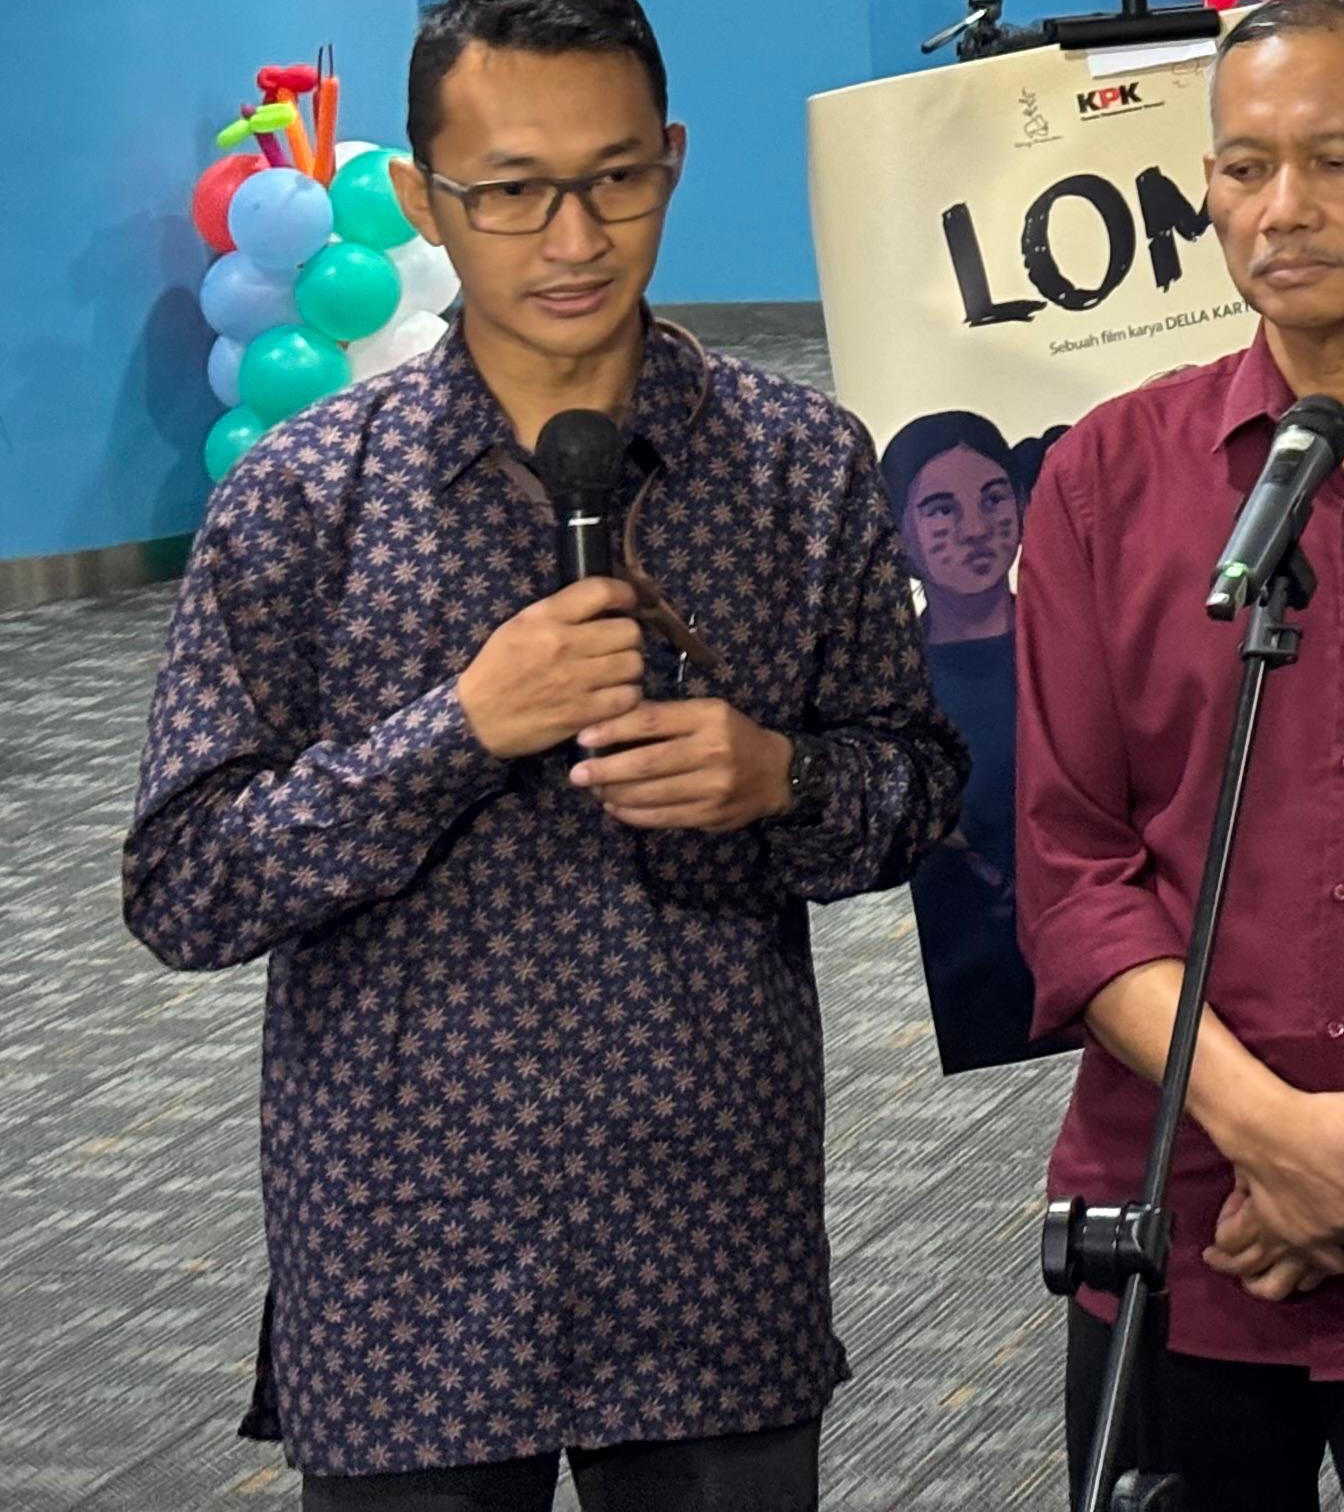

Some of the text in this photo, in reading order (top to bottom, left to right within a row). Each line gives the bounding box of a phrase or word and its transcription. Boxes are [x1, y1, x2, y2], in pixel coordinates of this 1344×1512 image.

[1077, 82, 1142, 113] KPK
[942, 165, 1212, 328] LOM
[1049, 301, 1250, 356] Sebuah film karya DELLA KART
